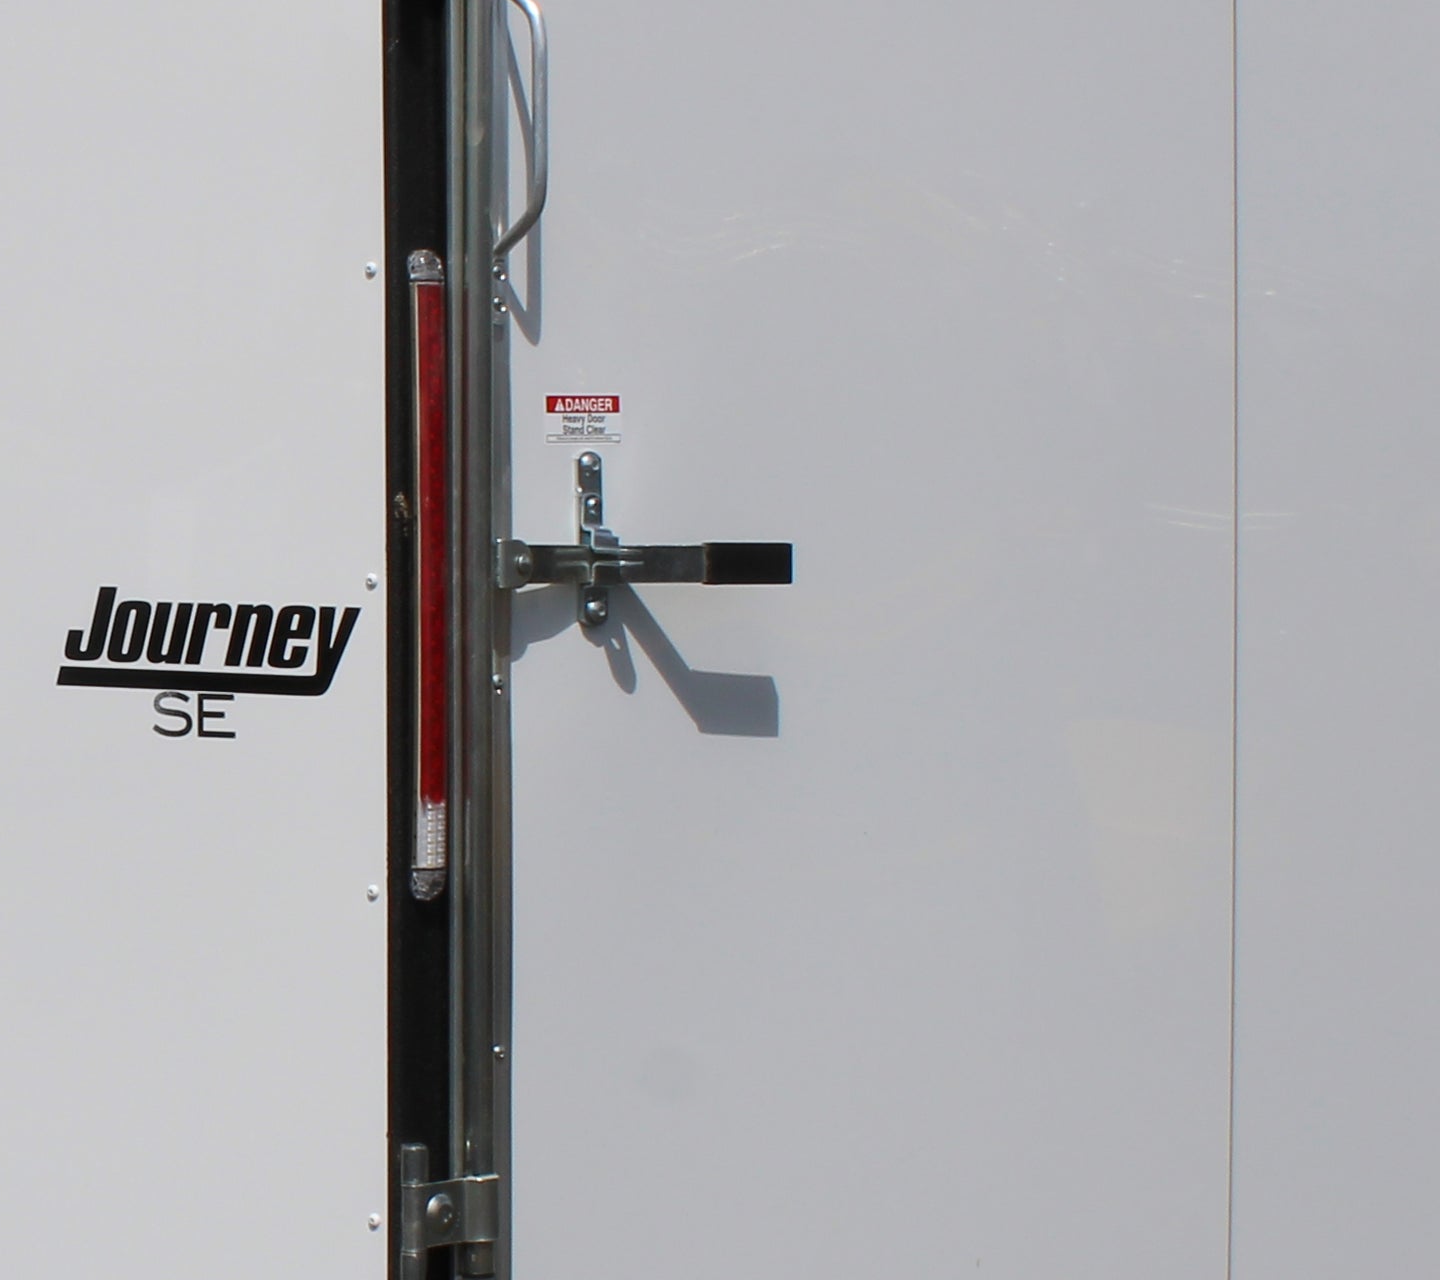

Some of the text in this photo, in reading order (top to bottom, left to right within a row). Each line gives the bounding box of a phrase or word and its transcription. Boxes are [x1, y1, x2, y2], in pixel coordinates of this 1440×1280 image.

[565, 398, 613, 412] DANGER
[562, 414, 606, 426] Heavy Door
[562, 425, 606, 435] Stand Clear
[59, 586, 362, 693] Journey
[153, 691, 236, 739] SE
